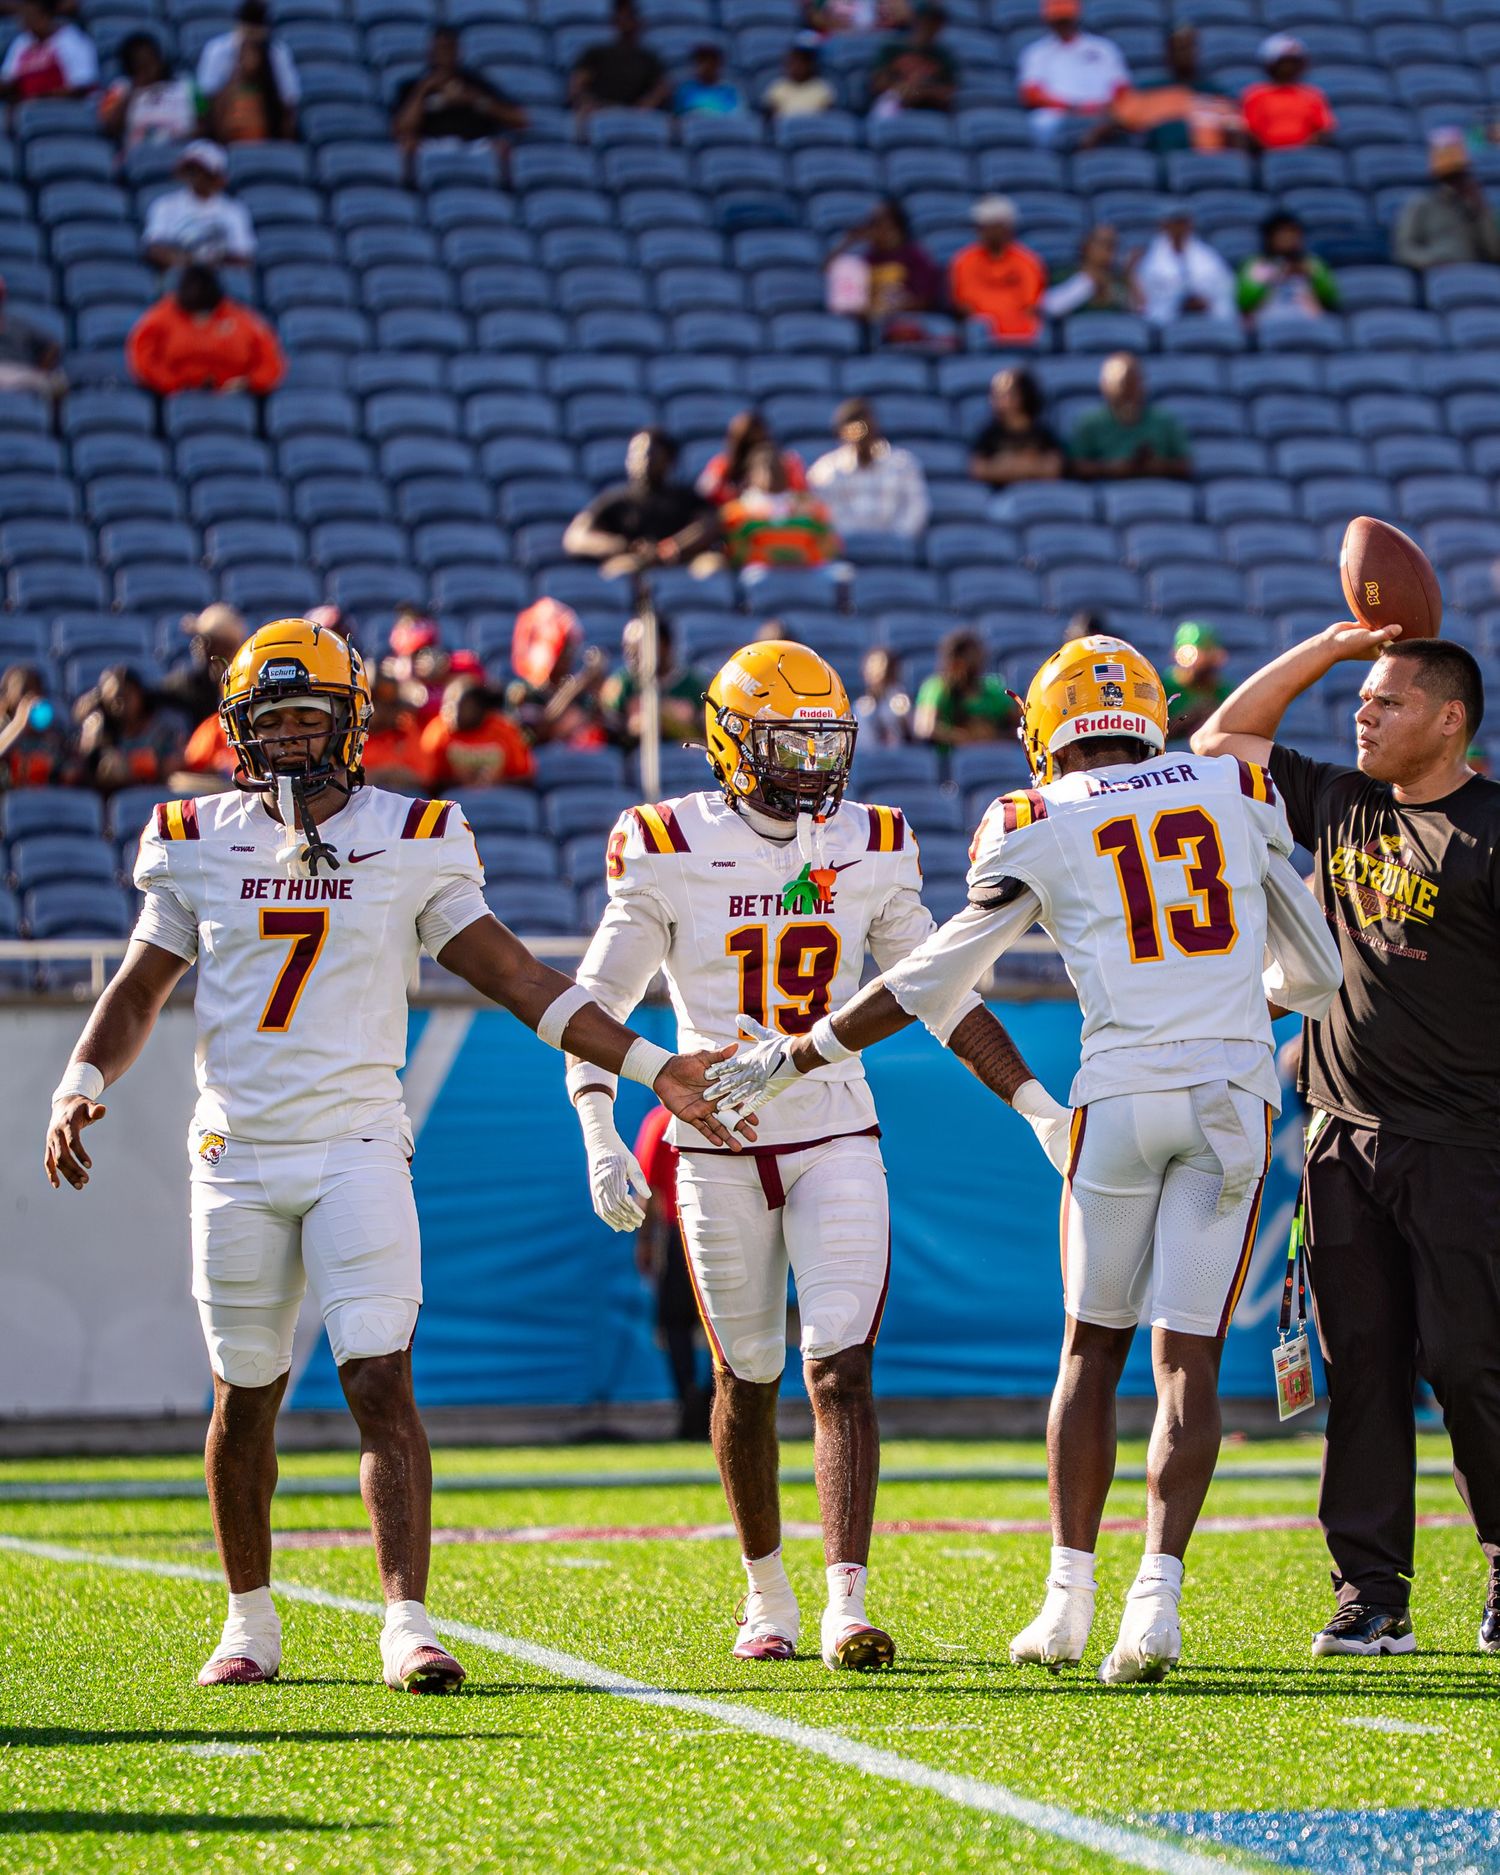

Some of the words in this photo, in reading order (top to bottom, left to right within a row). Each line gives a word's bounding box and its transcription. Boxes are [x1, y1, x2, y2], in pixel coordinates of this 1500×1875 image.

[1365, 582, 1380, 605] BCU
[800, 709, 833, 718] Riddell
[1074, 714, 1147, 734] Riddell
[240, 878, 354, 900] BETHUNE
[1092, 804, 1240, 964] 13
[256, 906, 331, 1033] 7
[725, 920, 842, 1041] 19
